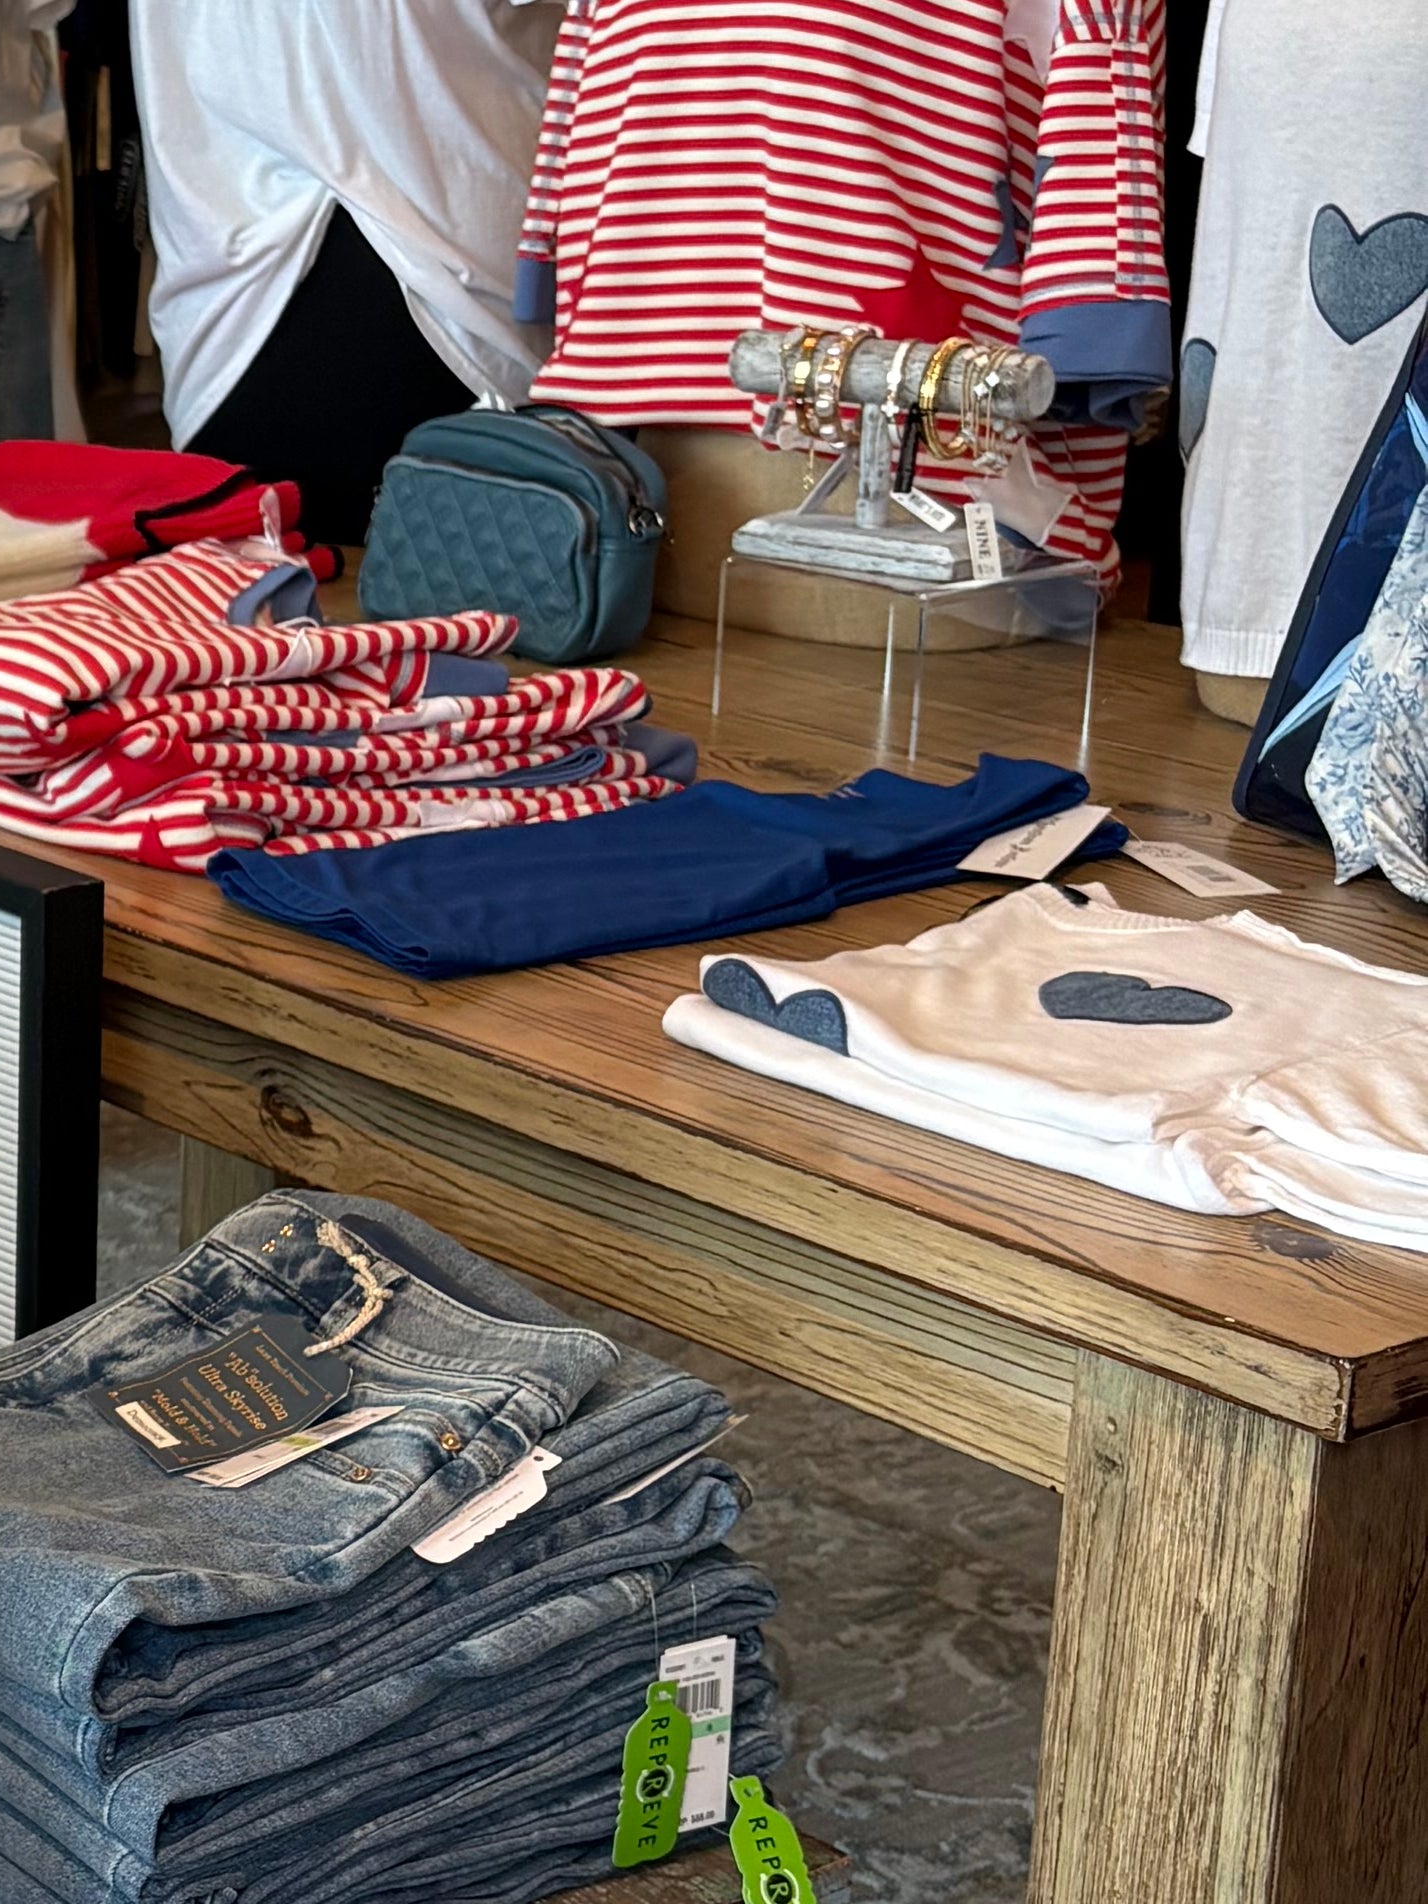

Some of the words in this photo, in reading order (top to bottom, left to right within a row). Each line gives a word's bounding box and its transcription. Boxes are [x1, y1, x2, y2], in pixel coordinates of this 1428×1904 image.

[198, 1363, 227, 1392] Ultra
[224, 1390, 266, 1430] Skyrise
[637, 1716, 671, 1849] REPREVE
